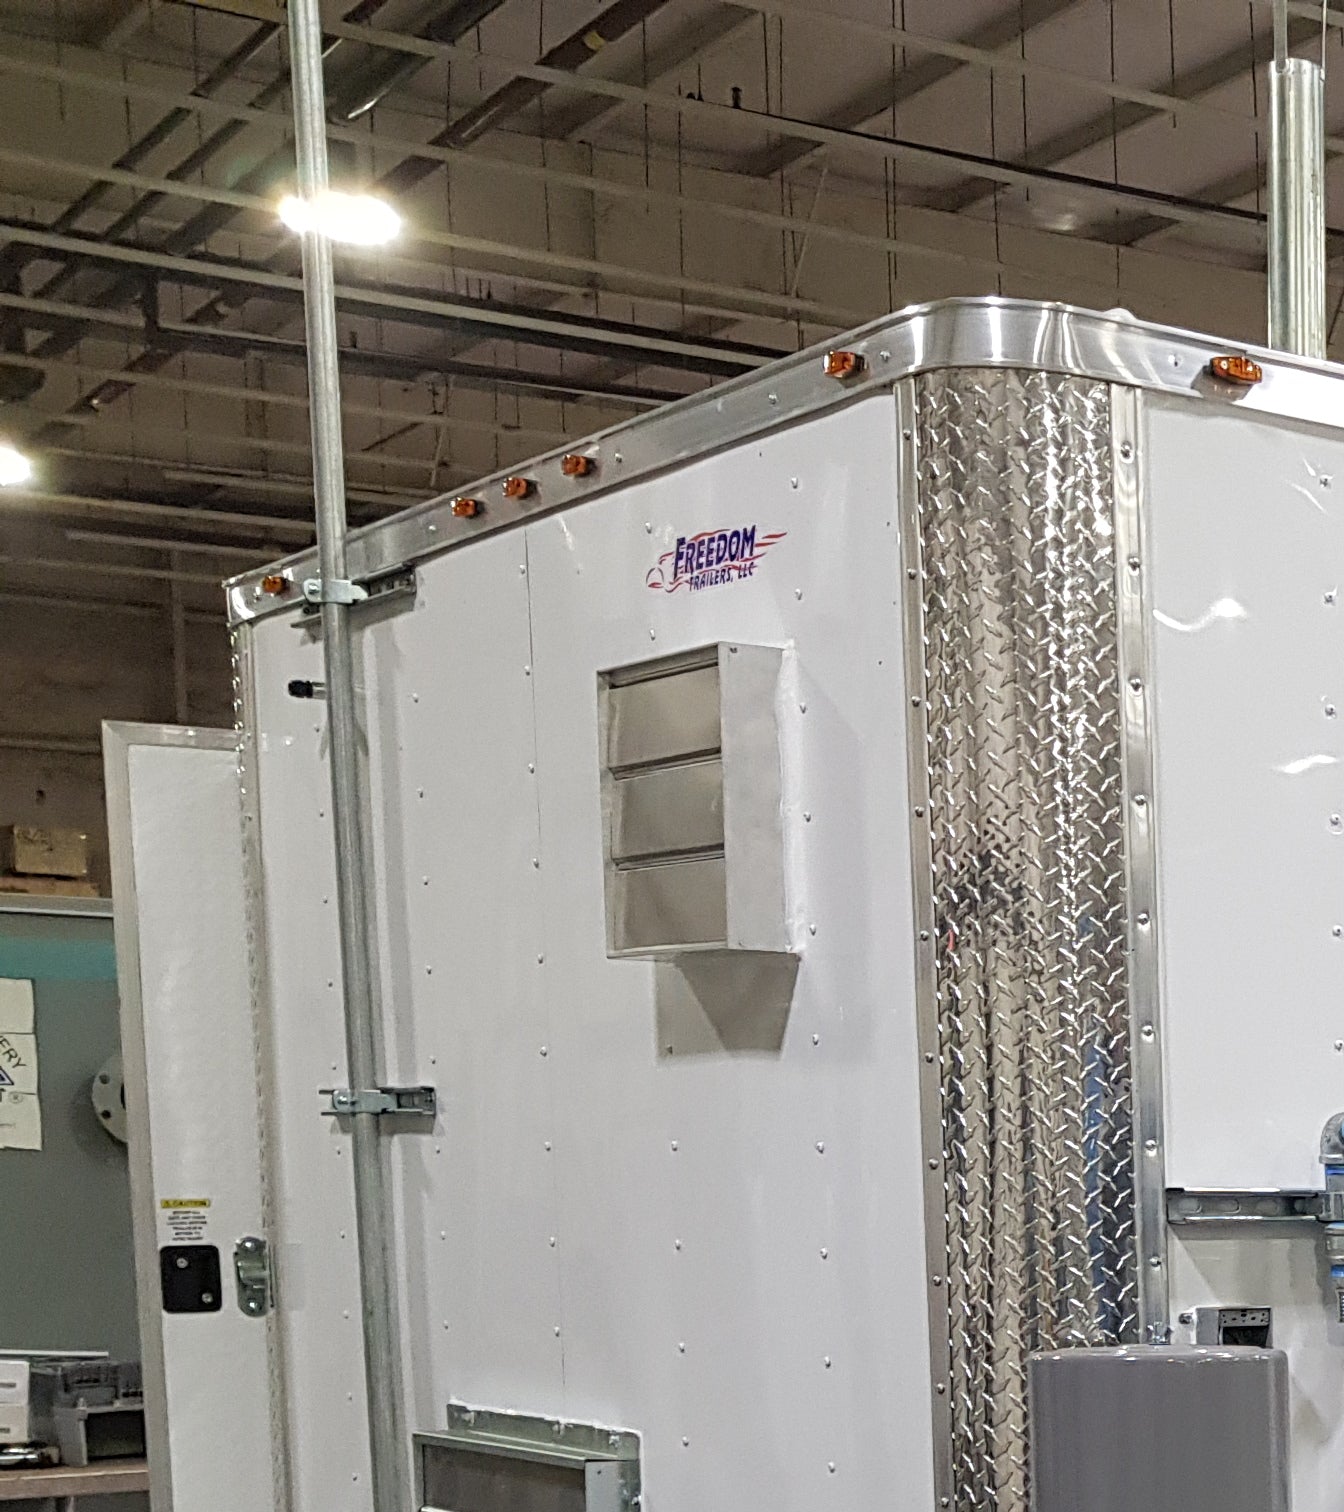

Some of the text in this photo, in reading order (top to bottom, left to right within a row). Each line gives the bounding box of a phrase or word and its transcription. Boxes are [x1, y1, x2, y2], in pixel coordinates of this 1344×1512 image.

[674, 525, 756, 580] FREEDOM
[689, 562, 755, 591] TRAILERS, LLC
